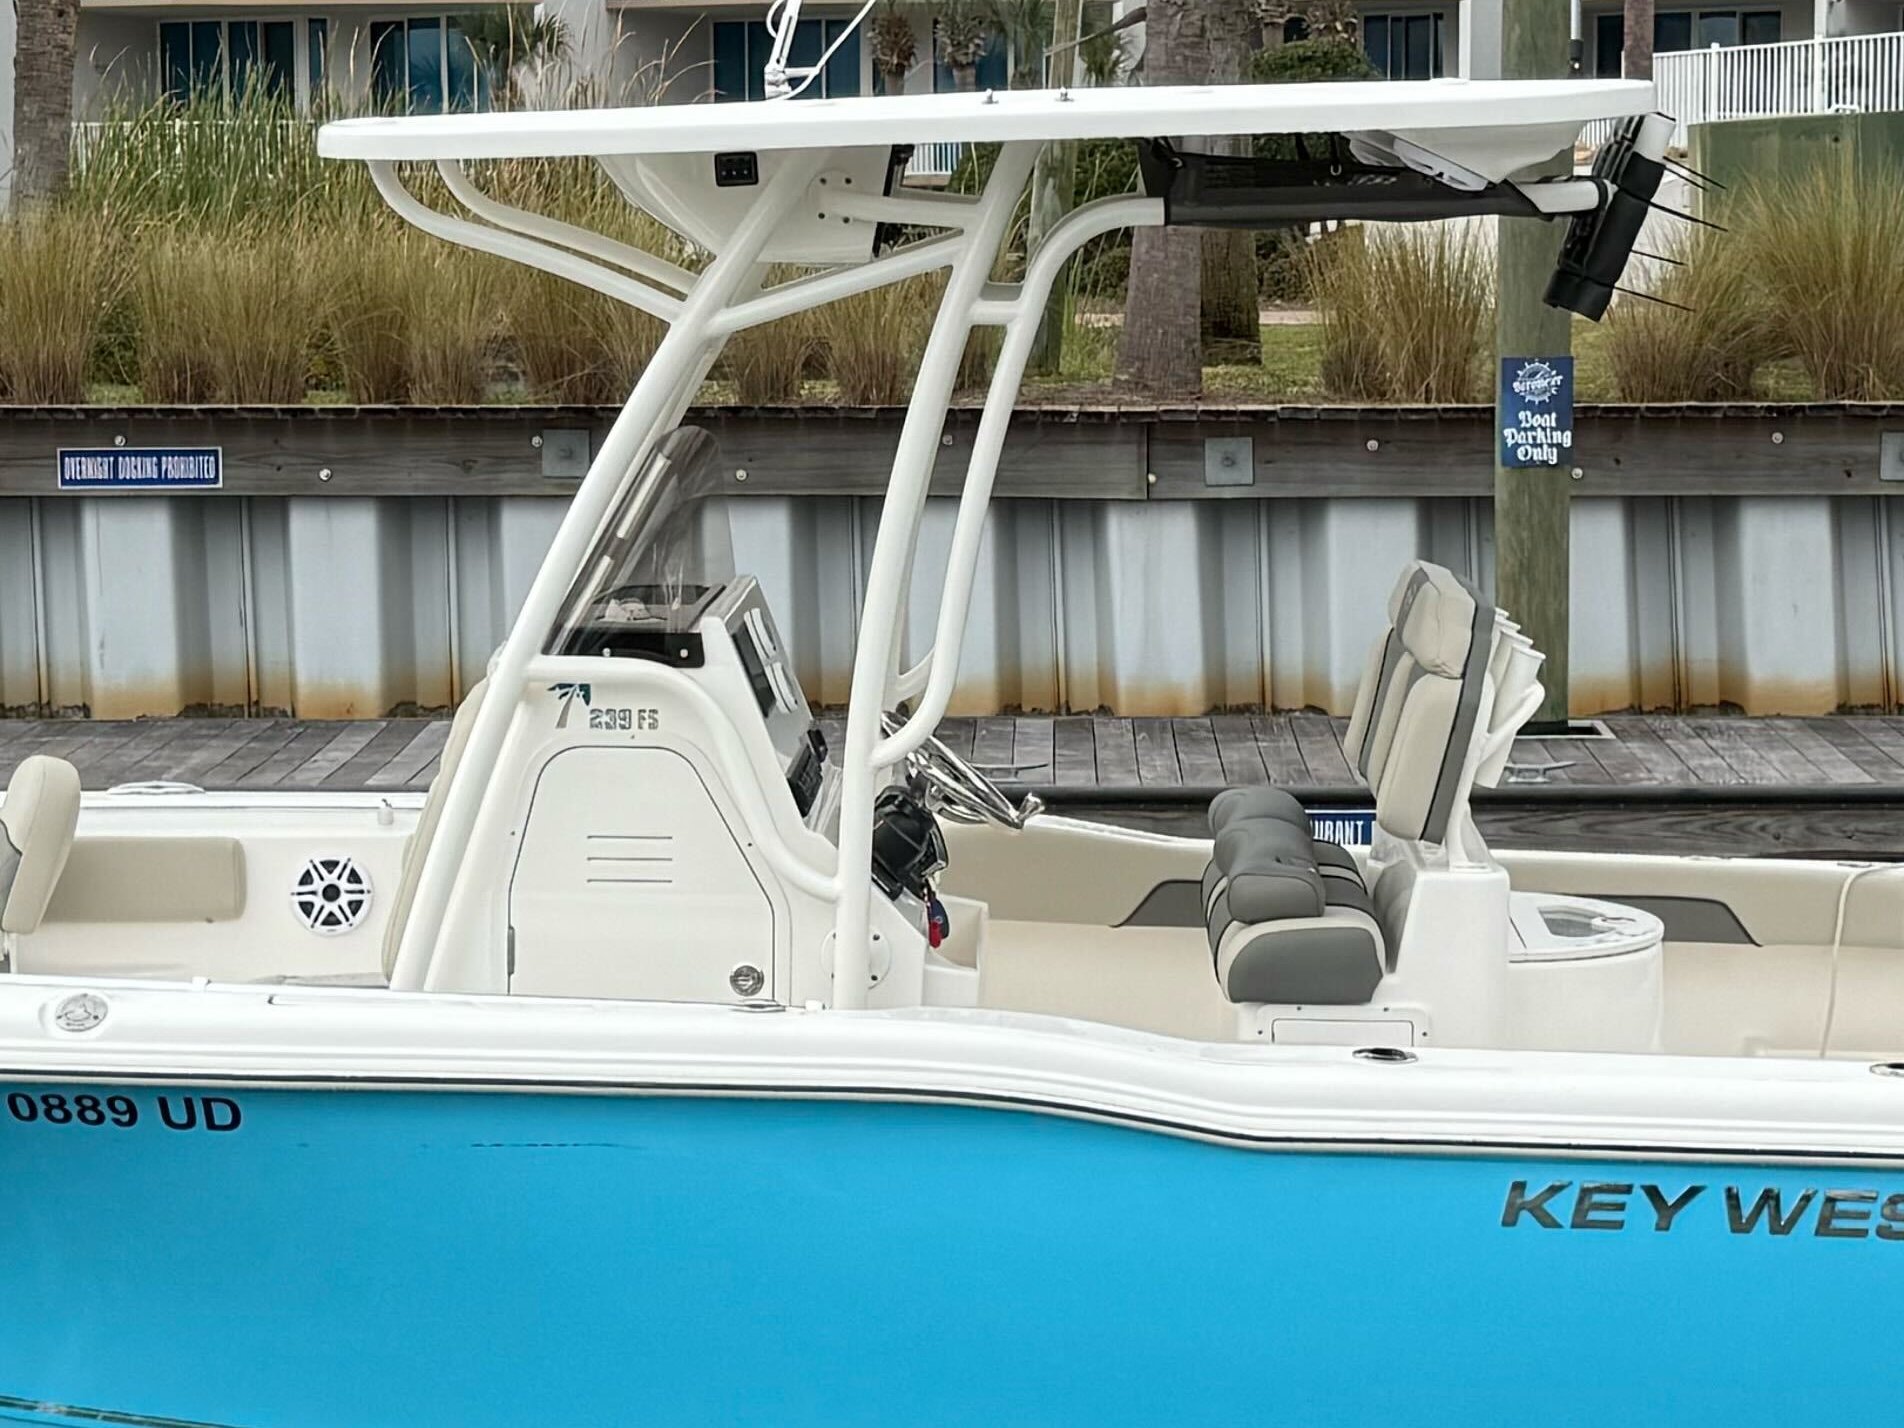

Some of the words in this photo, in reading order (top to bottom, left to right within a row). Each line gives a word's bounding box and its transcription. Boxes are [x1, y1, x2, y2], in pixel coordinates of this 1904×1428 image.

[1518, 411, 1556, 427] Boat
[1503, 428, 1572, 448] Parking
[1517, 444, 1558, 464] Only
[64, 456, 114, 480] OVERNIGHT
[118, 456, 158, 479] DOCKING
[161, 455, 216, 479] PROHIBITED
[589, 708, 632, 730] 239
[637, 708, 659, 730] FS
[7, 1092, 138, 1128] 0889
[157, 1096, 242, 1132] UD
[1501, 1180, 1708, 1232] KEY
